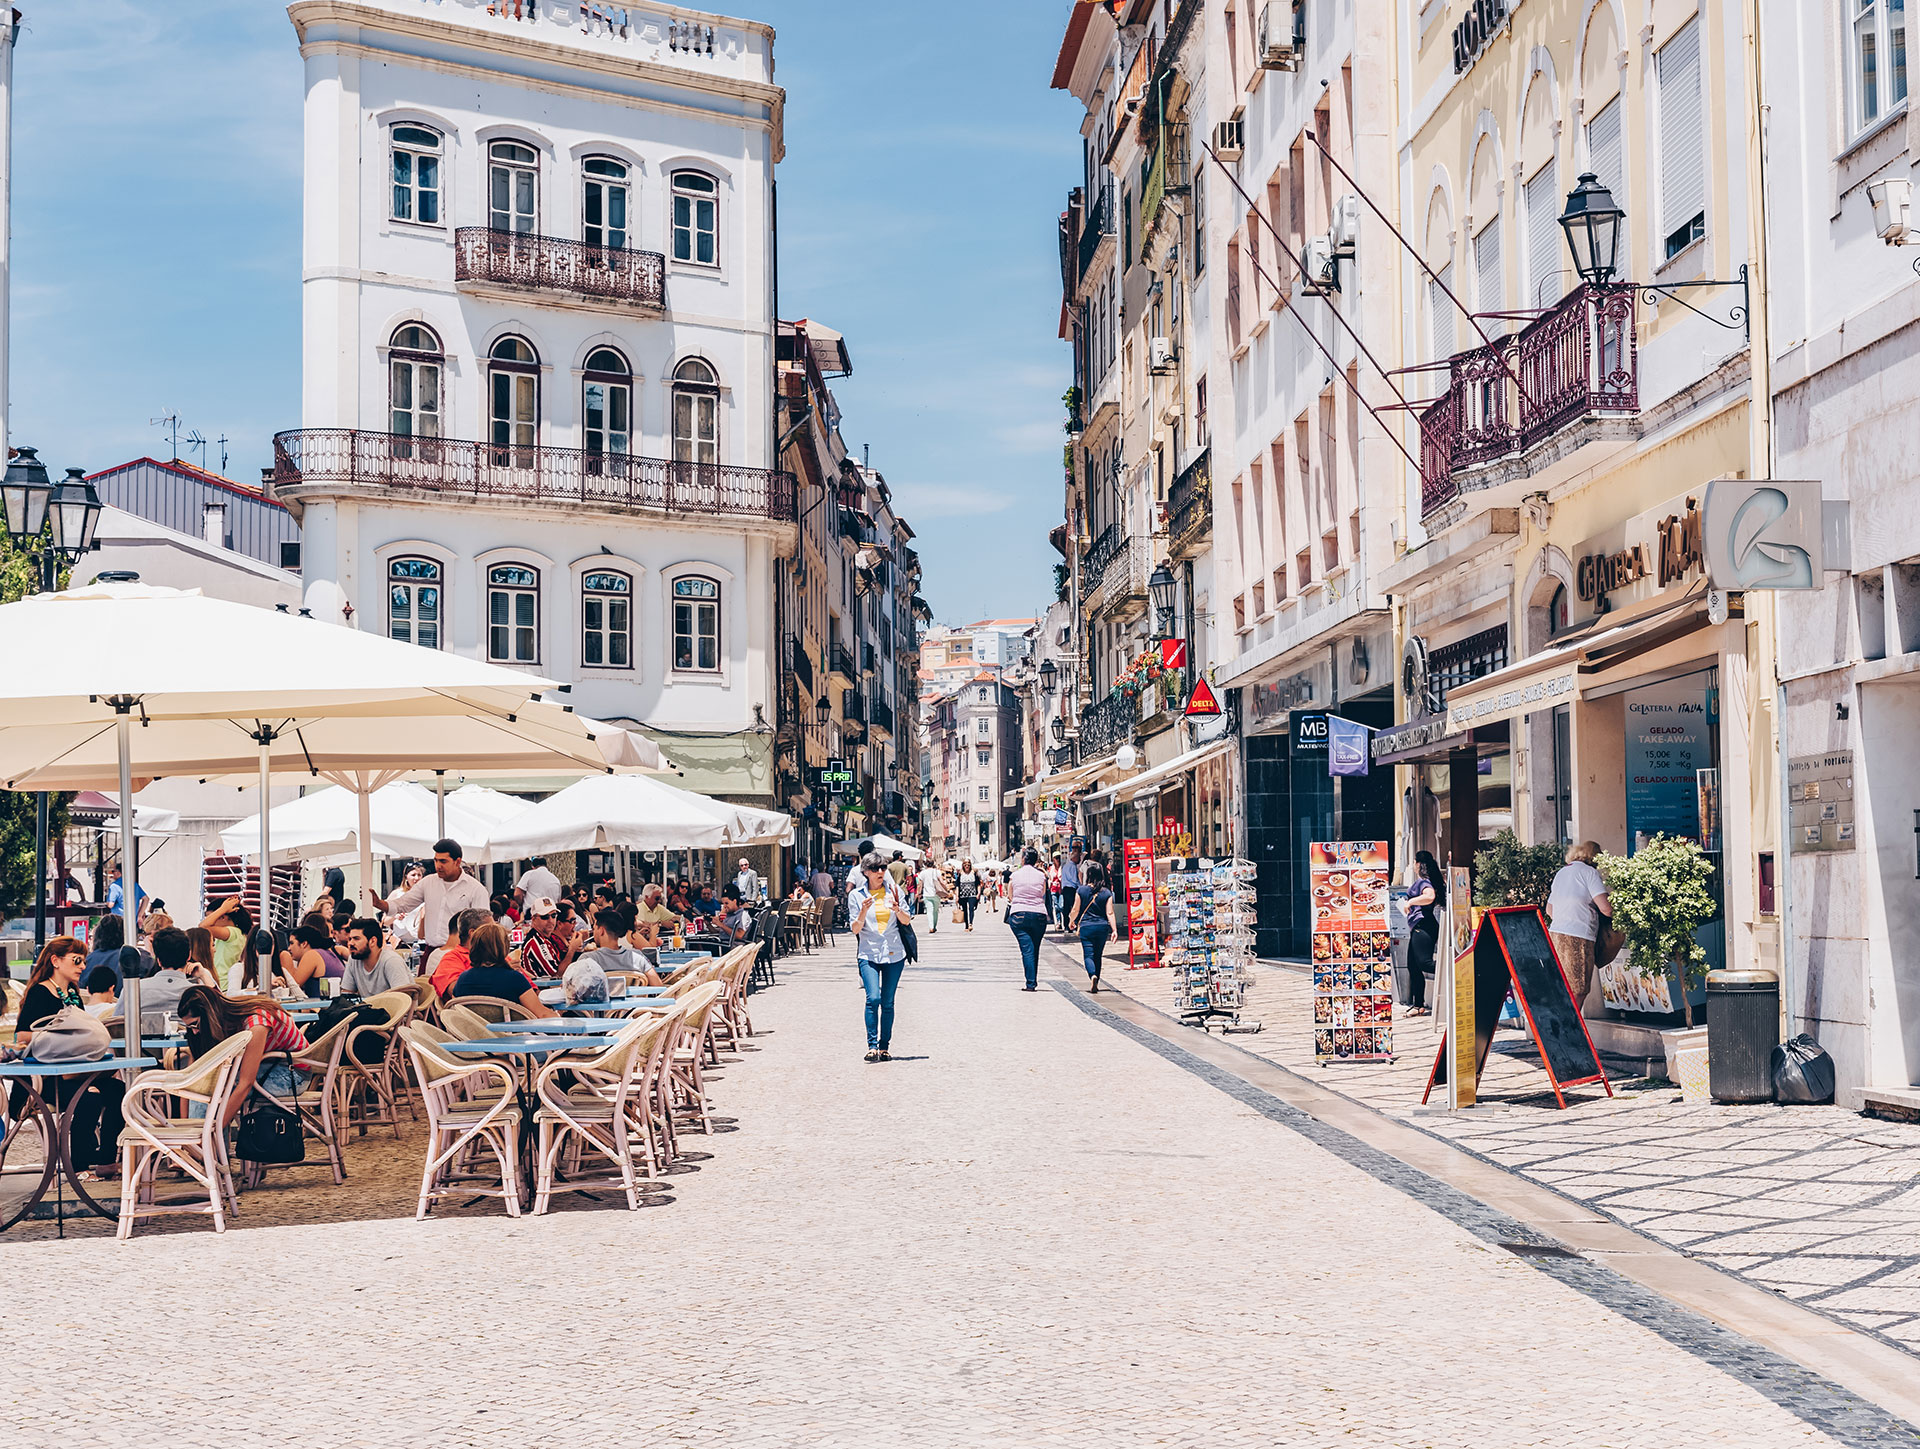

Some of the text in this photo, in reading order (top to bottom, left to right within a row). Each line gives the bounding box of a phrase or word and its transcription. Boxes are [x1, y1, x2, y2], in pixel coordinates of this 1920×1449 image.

[1192, 700, 1214, 708] DELTA
[1629, 702, 1704, 715] GELATERIA ITALIA
[1300, 722, 1328, 736] MB
[1638, 735, 1697, 743] TAKE-AWAY
[1645, 751, 1691, 760] 15,00€ Kg
[1649, 761, 1671, 769] 7,50€
[1633, 776, 1698, 784] GELADO VITRIN
[1322, 842, 1378, 856] GELATARIA
